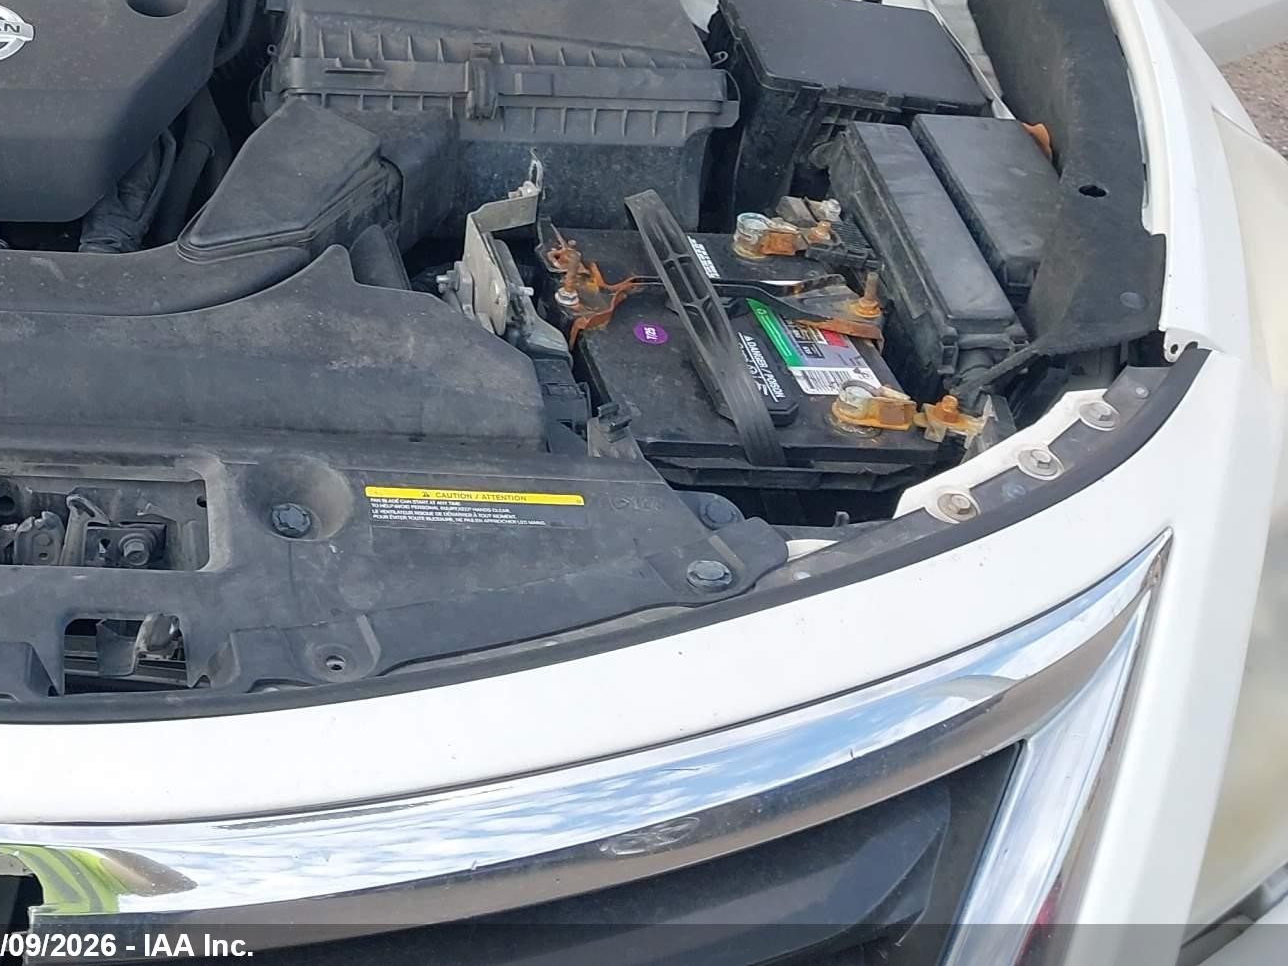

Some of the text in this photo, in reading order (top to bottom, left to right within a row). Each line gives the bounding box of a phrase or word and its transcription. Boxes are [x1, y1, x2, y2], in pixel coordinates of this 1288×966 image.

[746, 340, 769, 368] DANGER
[764, 374, 787, 398] POISON
[435, 491, 473, 499] CAUTION
